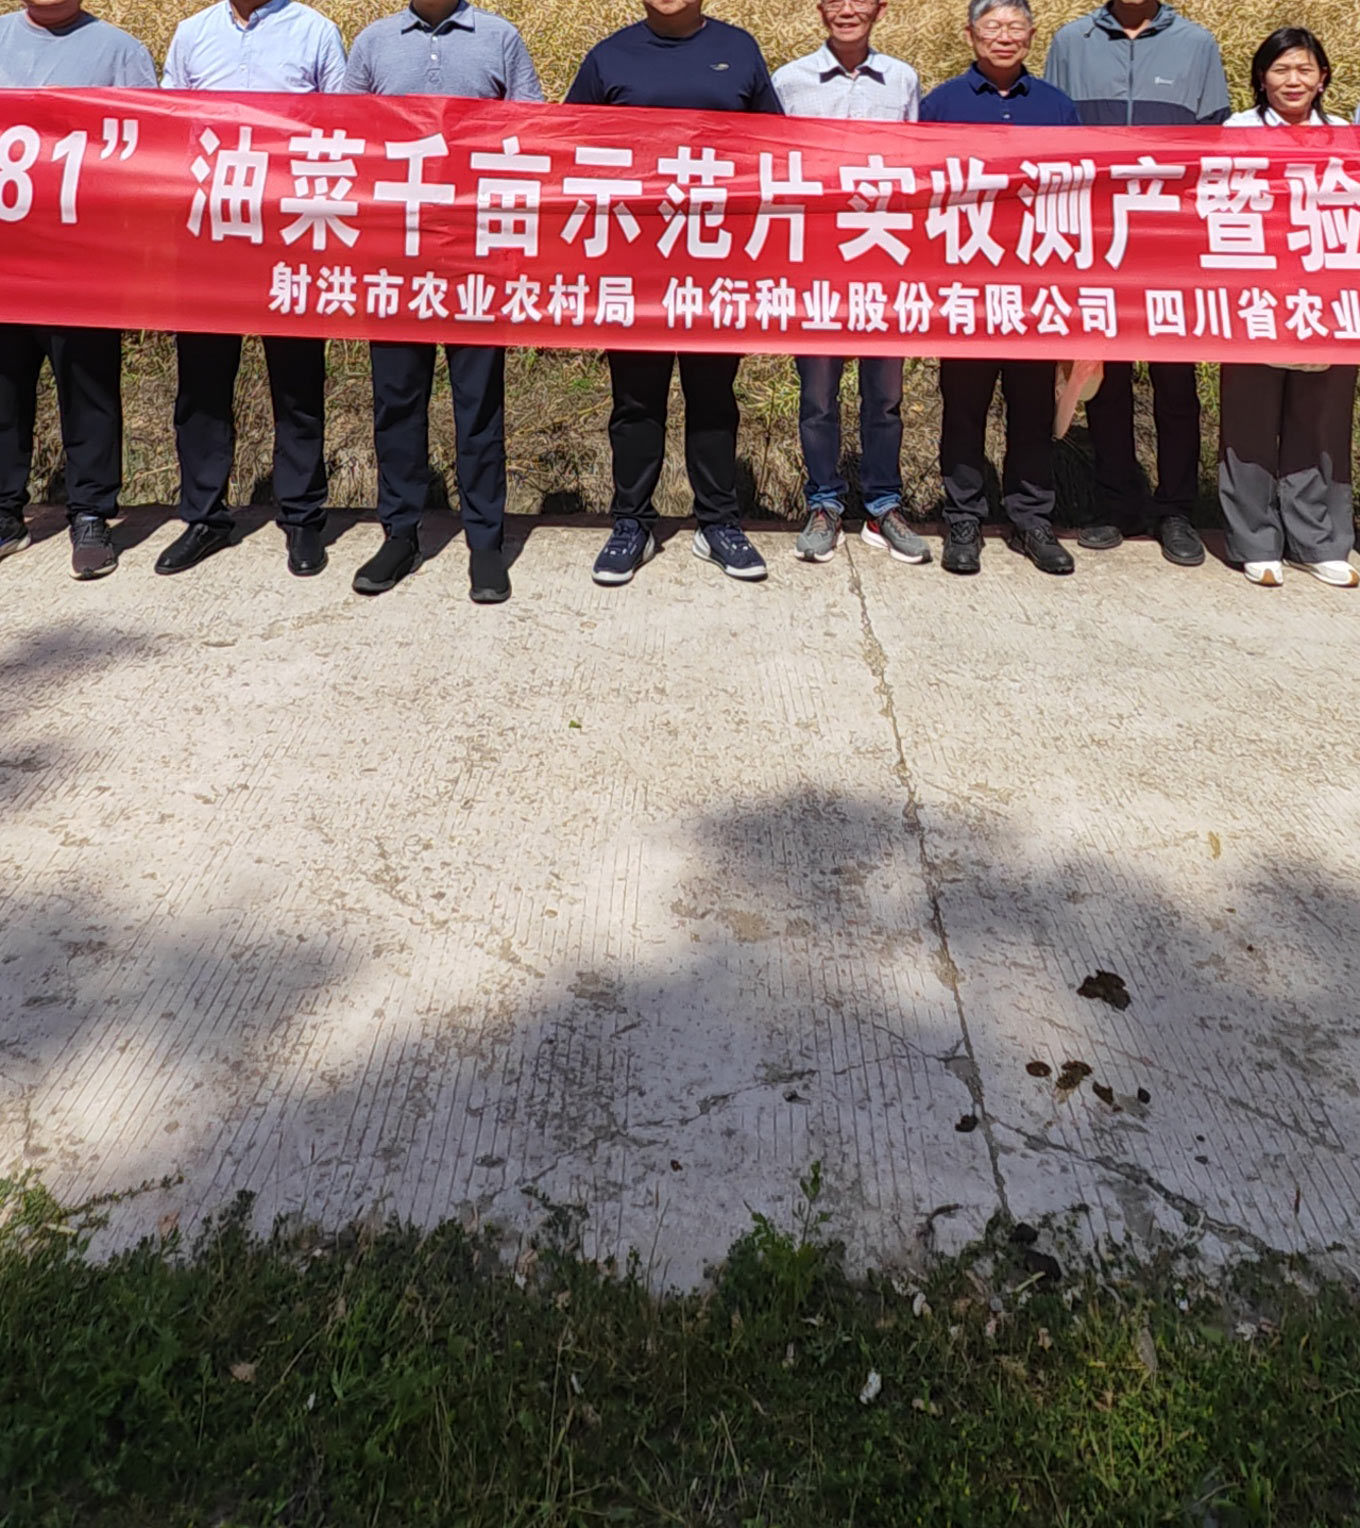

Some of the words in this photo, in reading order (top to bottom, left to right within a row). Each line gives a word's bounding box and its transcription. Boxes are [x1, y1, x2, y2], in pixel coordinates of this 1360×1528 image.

[268, 261, 635, 327] 射洪市农业农村局
[661, 276, 1118, 338] 仲衍种业股份有限公司
